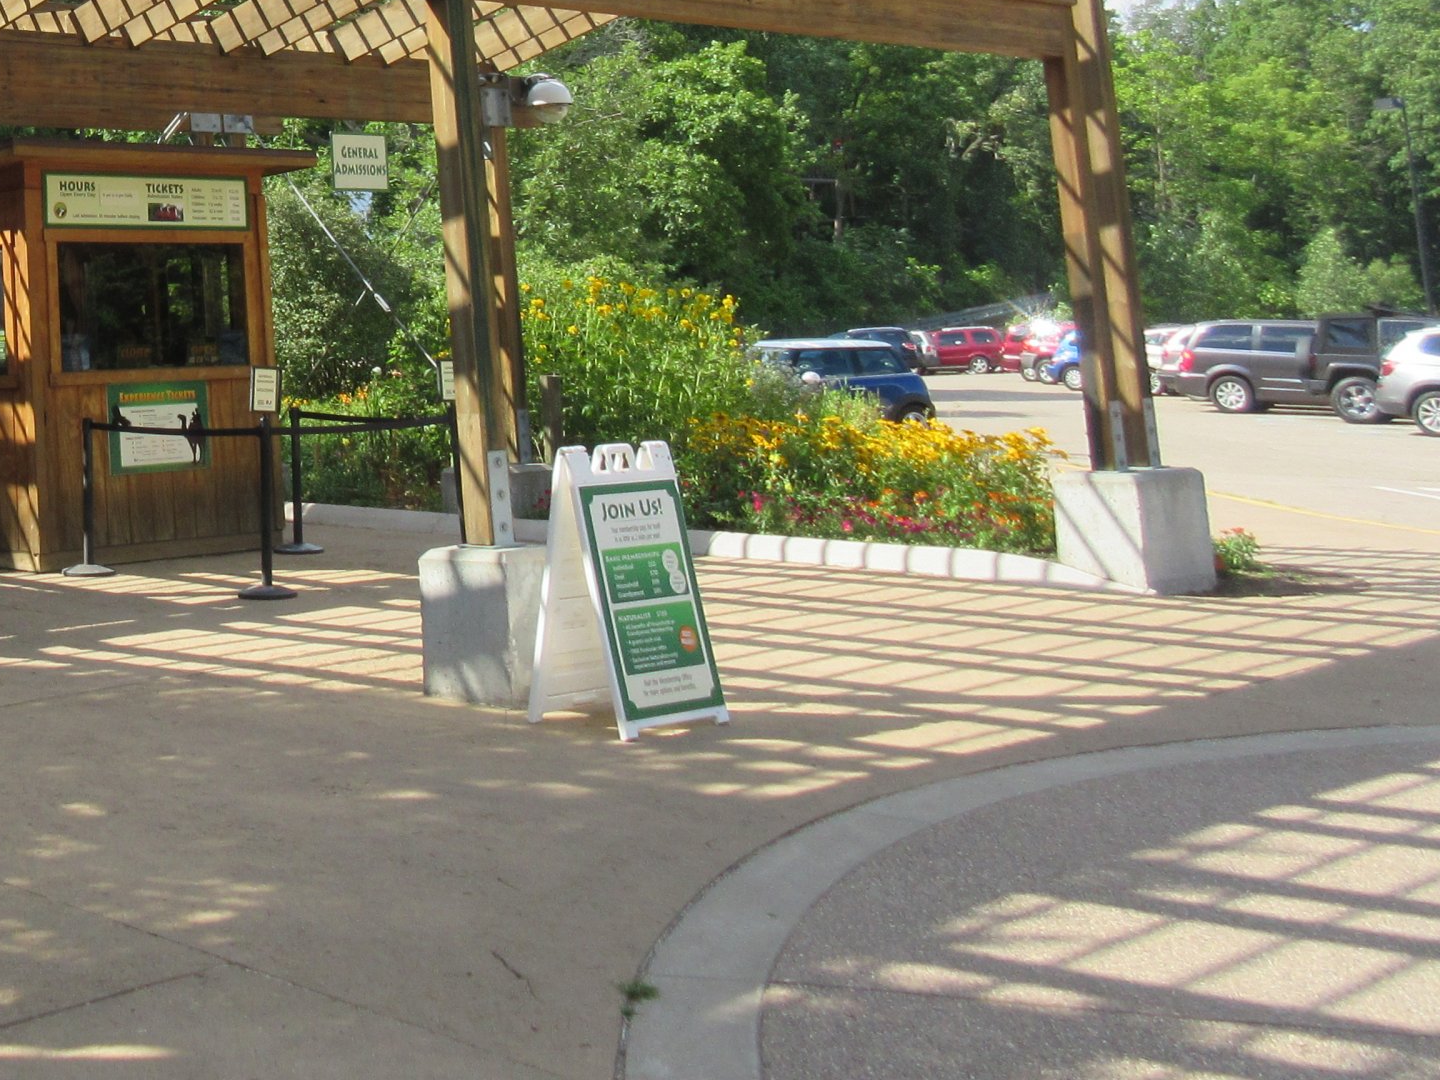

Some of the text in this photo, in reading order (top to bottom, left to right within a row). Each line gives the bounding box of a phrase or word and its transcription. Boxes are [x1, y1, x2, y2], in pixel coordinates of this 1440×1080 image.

[341, 145, 378, 159] GENERAL
[335, 161, 386, 176] ADMISSIONS
[59, 181, 96, 192] HOURS
[145, 183, 184, 194] TICKETS
[166, 390, 197, 400] TICKETS
[601, 498, 663, 522] JOIN US!
